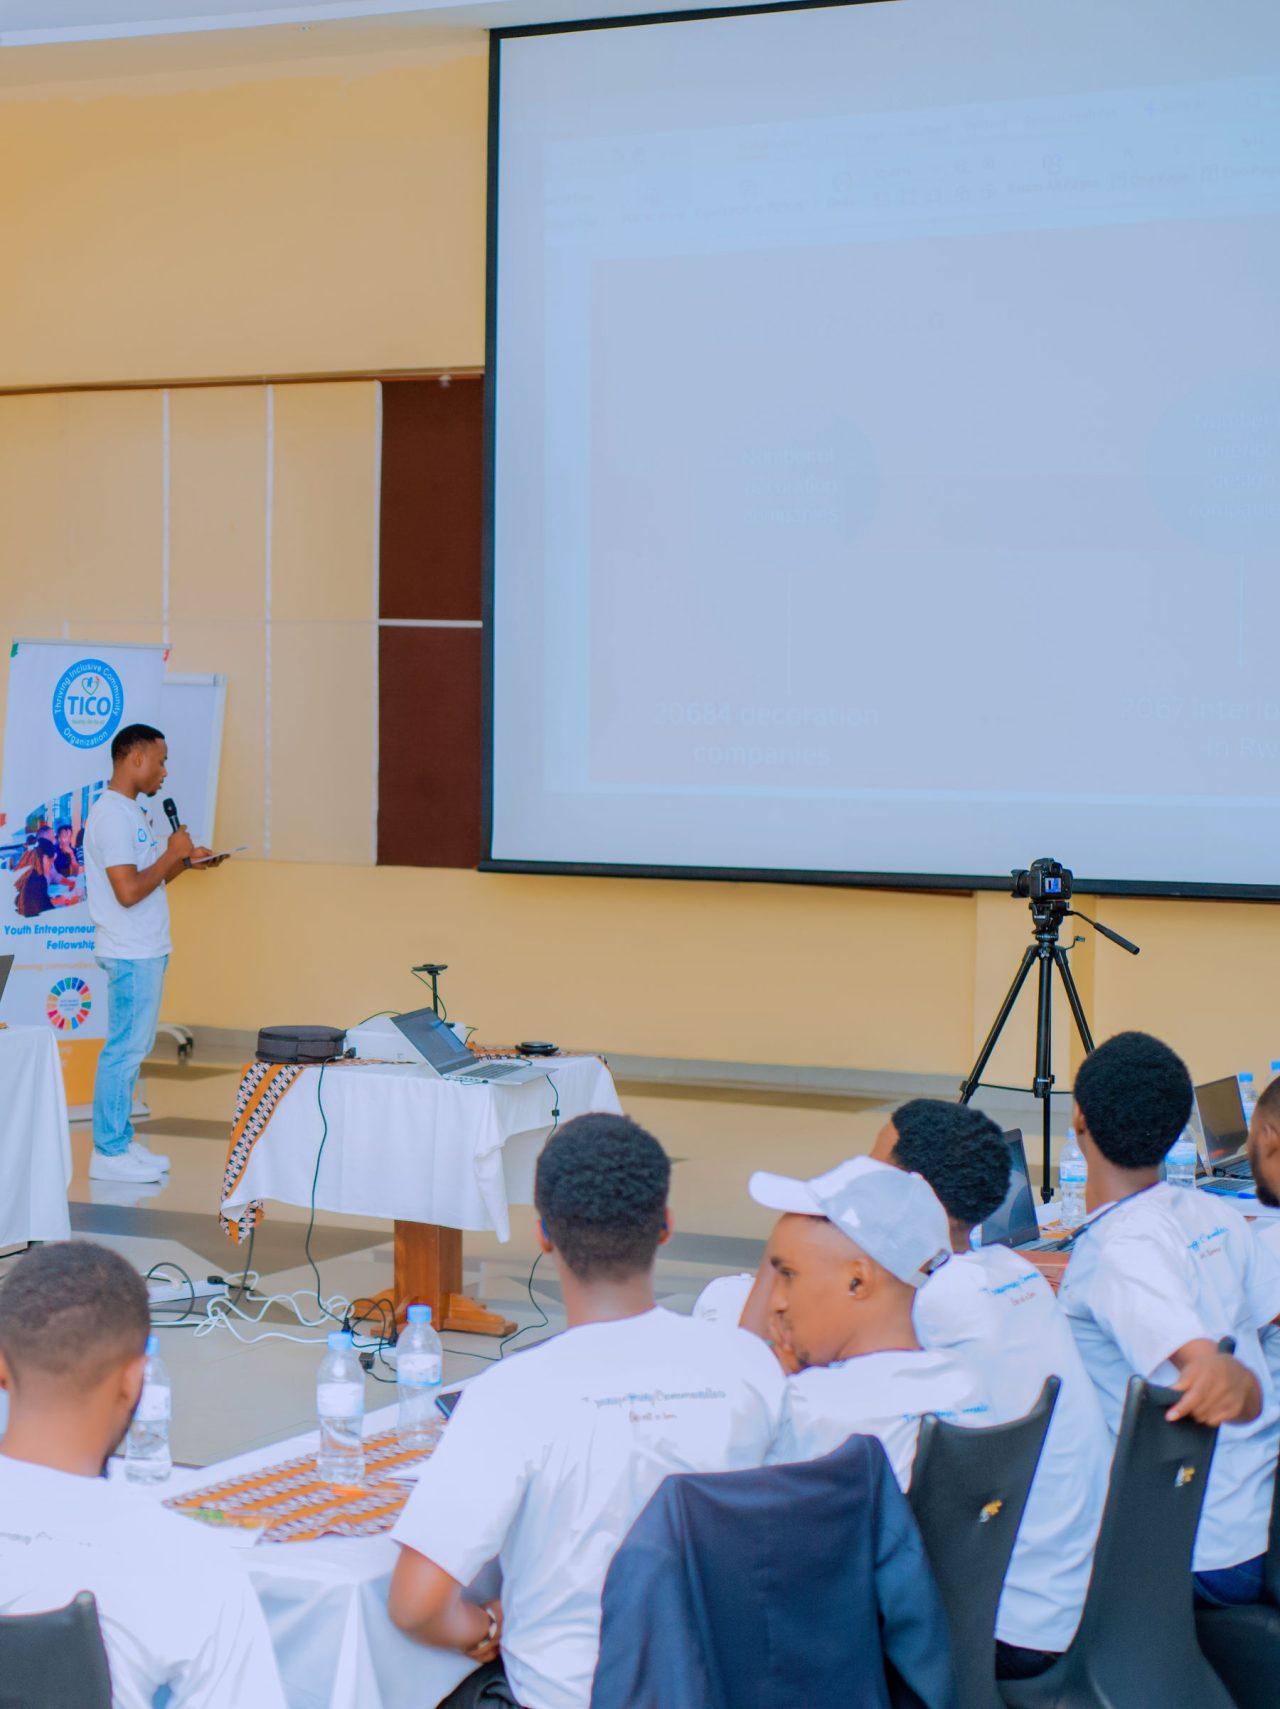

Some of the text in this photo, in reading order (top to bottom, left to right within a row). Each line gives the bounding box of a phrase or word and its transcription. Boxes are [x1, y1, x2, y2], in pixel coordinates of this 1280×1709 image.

[54, 663, 121, 717] Thriving Inclusive Community
[67, 695, 112, 717] TICO
[63, 727, 108, 747] Organization
[4, 925, 32, 936] Youth
